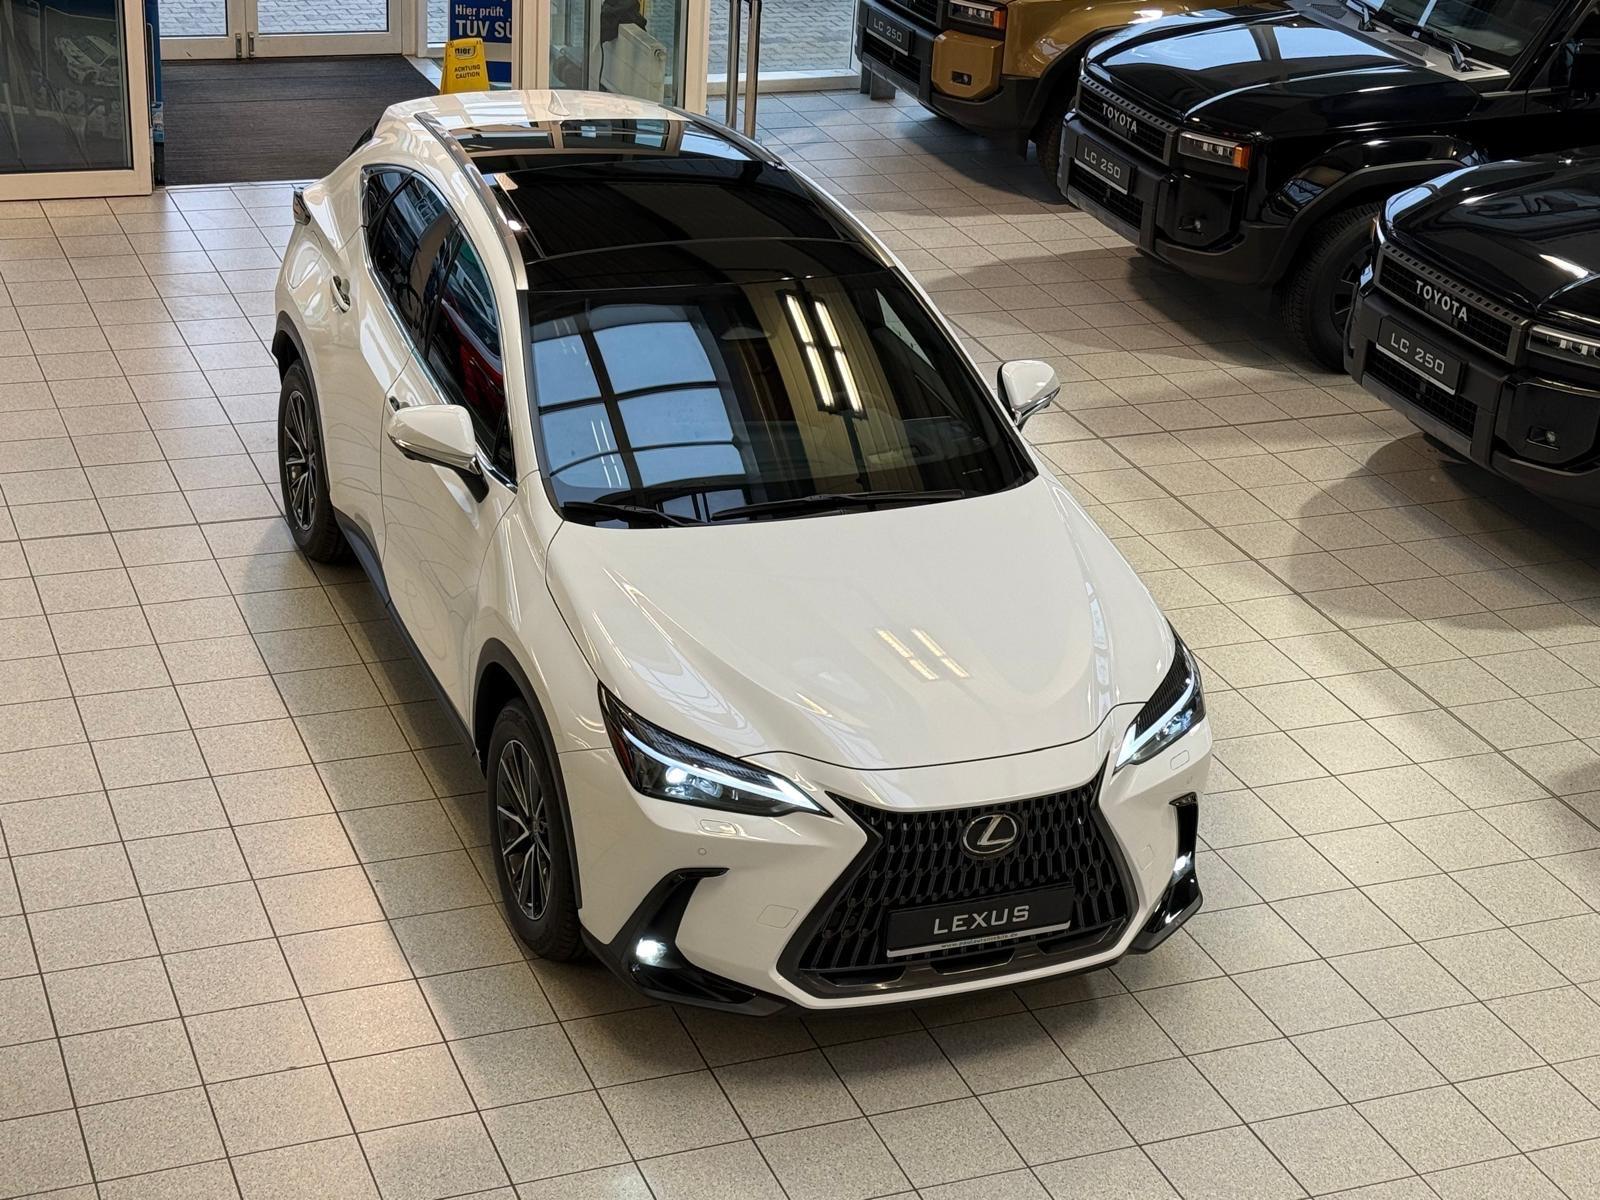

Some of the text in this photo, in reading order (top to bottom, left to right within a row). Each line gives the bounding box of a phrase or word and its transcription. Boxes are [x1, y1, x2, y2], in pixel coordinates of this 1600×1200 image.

[455, 4, 504, 19] Hier prüft
[455, 16, 490, 37] TÜV
[886, 25, 902, 42] 250
[454, 64, 481, 73] ACHTUNG
[455, 71, 481, 79] CAUTION
[1102, 102, 1137, 133] TOYOTA
[1084, 147, 1121, 179] LC 250
[1416, 279, 1468, 322] TOYOTA
[1390, 333, 1410, 354] LC
[1414, 347, 1445, 375] 250
[933, 905, 1030, 935] LEXUS
